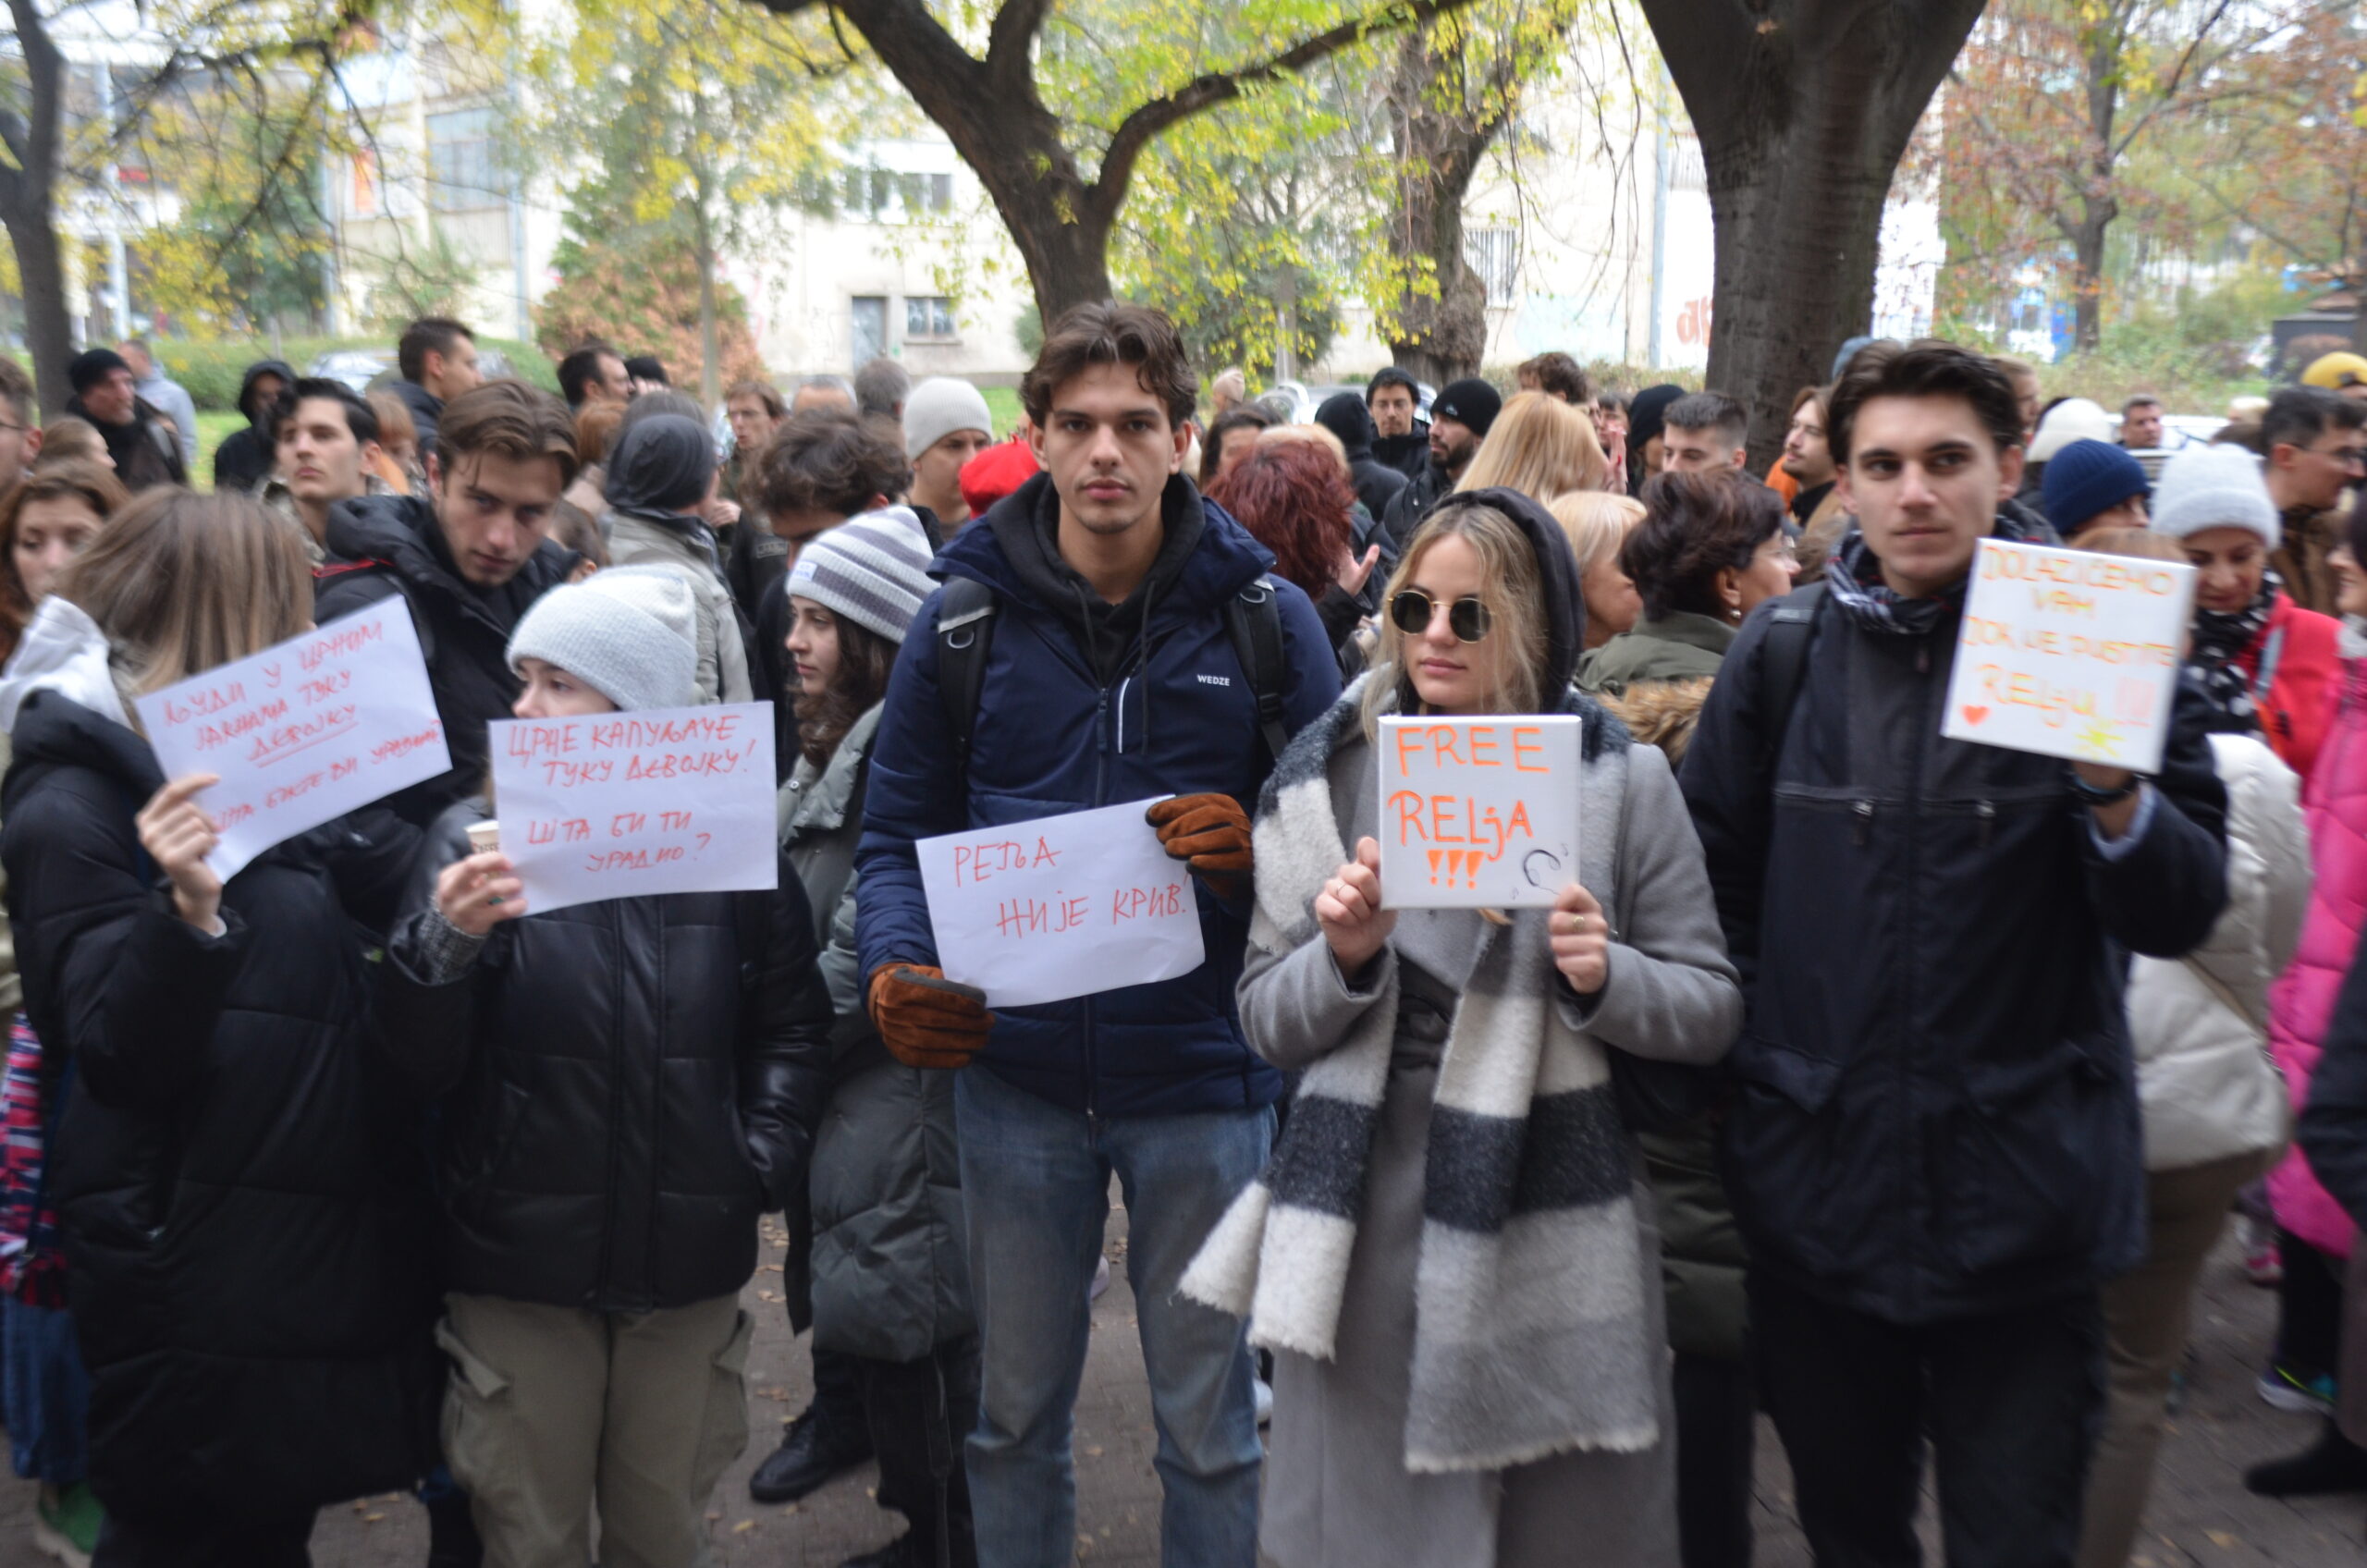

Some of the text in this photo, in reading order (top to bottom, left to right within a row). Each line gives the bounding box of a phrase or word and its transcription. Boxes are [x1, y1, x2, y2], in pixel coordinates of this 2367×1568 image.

[262, 662, 282, 688] У
[297, 669, 351, 705] ТУКУ
[1196, 673, 1231, 687] WEDZE
[509, 716, 742, 767] ЦРНЕ КАПУЉАЧЕ
[1396, 724, 1551, 777] FREE
[542, 759, 614, 787] ТУКУ
[527, 810, 693, 844] ШТА БИ ТИ
[953, 836, 1062, 888] РЕЉА
[1427, 850, 1485, 890] !!!
